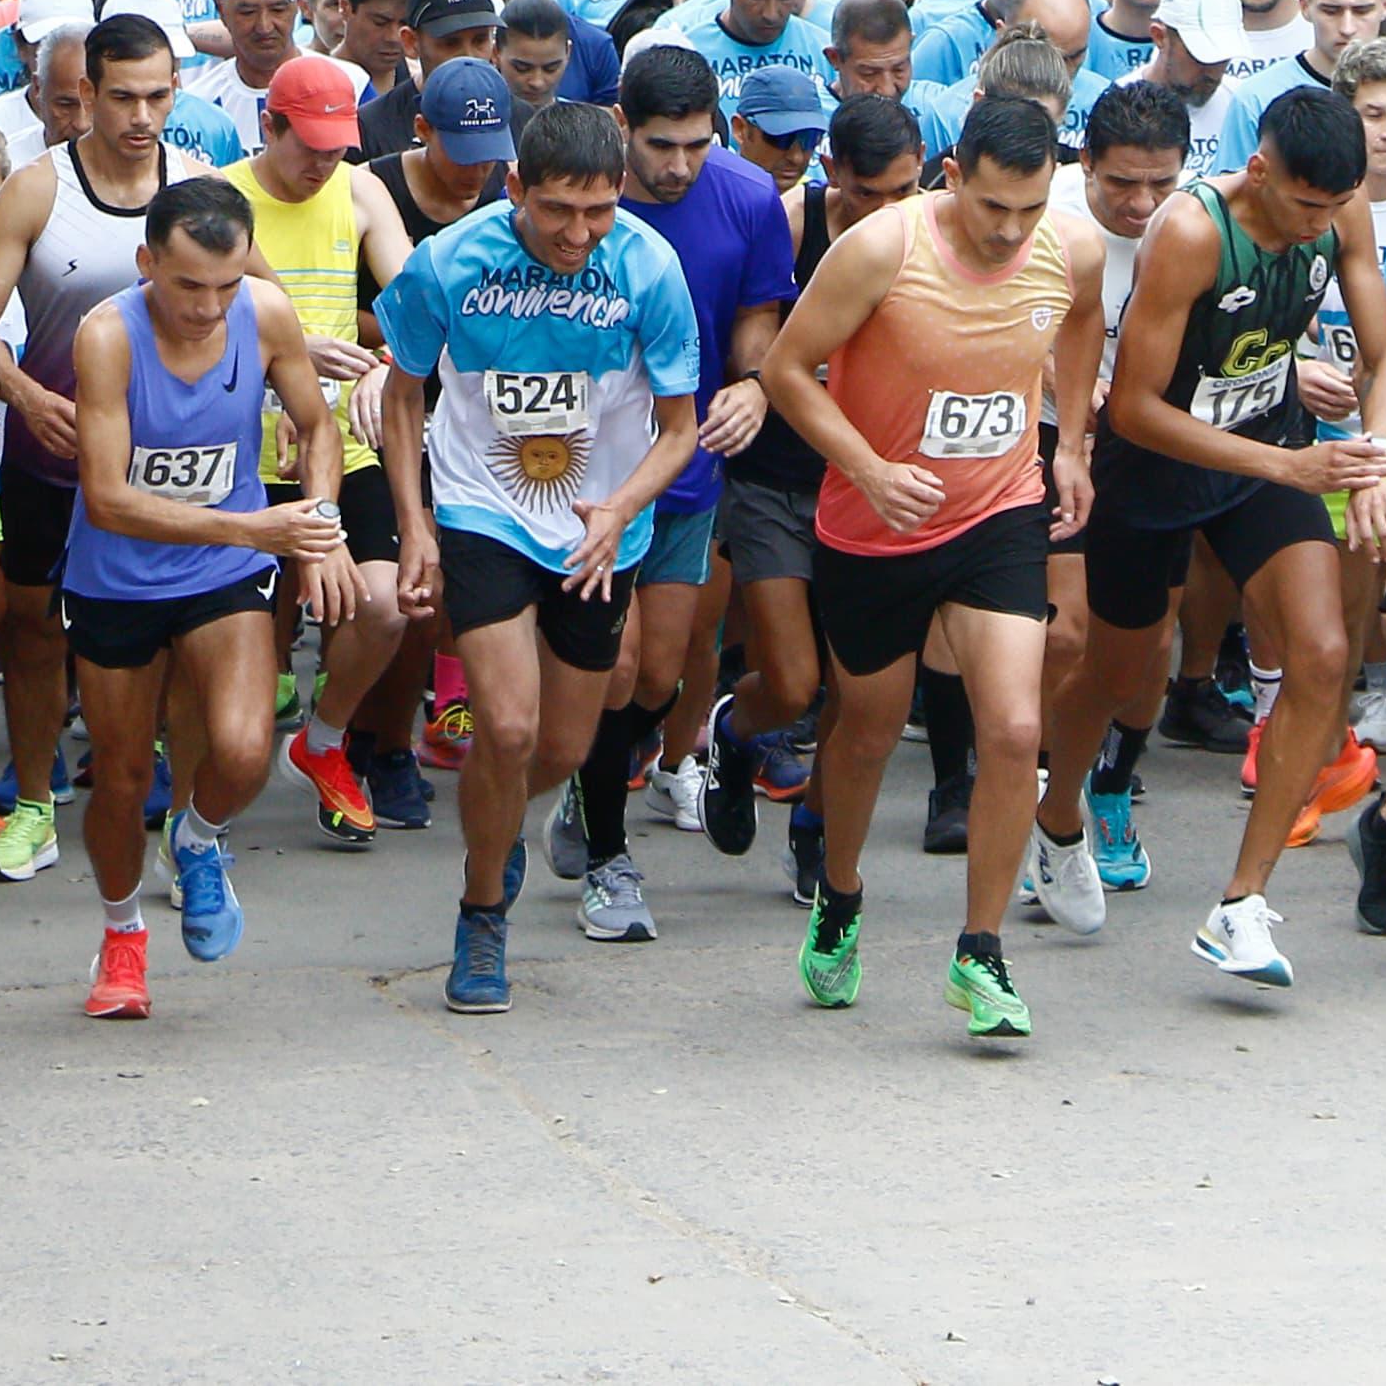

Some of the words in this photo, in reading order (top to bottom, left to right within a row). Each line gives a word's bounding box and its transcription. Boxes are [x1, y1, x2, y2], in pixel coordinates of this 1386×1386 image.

[496, 373, 579, 415] 524
[940, 394, 1016, 439] 673
[143, 447, 226, 488] 637
